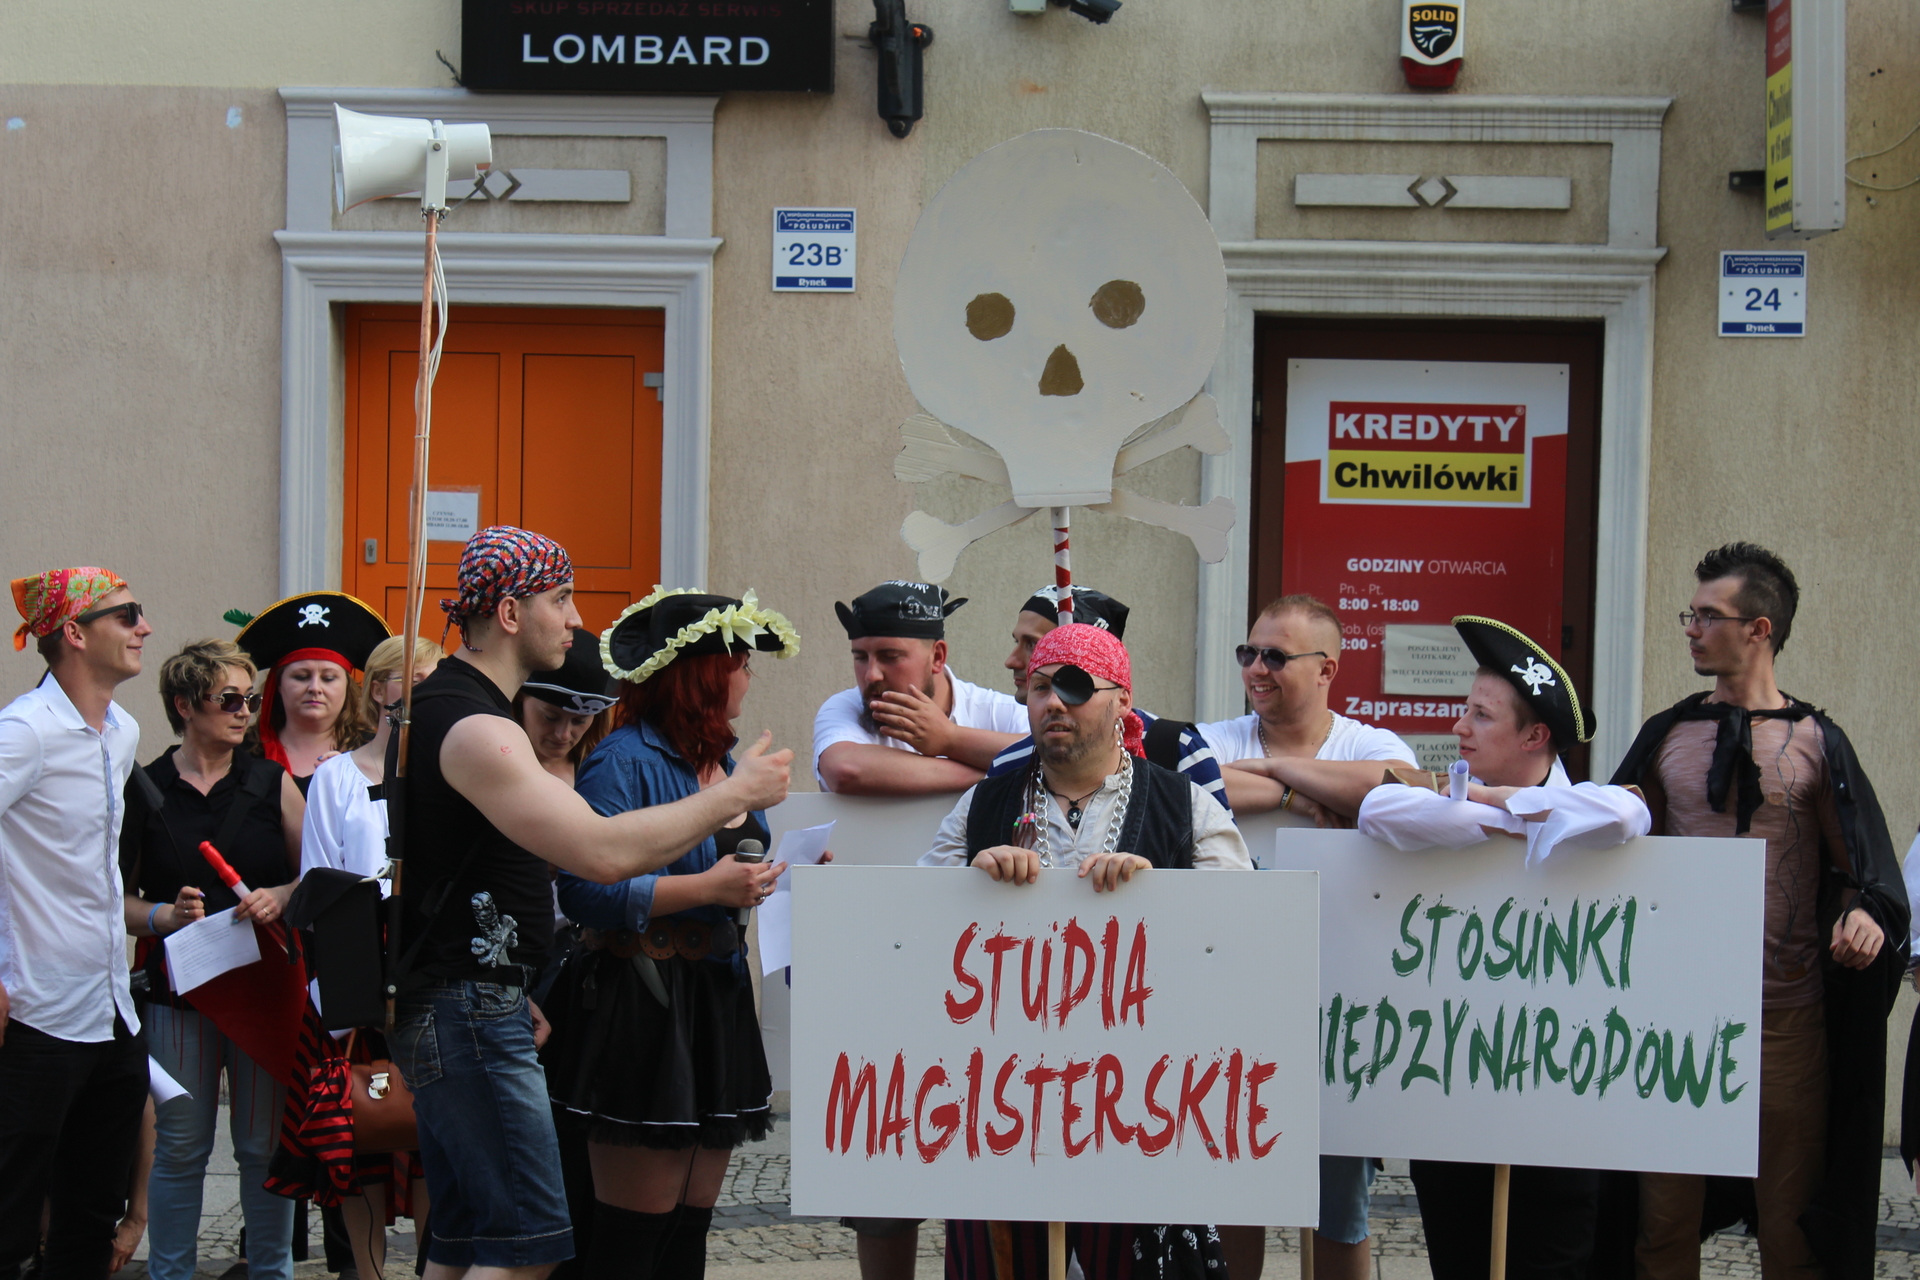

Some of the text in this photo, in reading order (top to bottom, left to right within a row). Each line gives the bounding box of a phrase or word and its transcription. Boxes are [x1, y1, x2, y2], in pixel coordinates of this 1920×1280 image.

[510, 0, 569, 15] SKUP
[698, 2, 783, 18] SERWIS
[1412, 9, 1456, 22] SOLID
[522, 33, 770, 66] LOMBARD
[789, 242, 842, 266] 23B
[798, 278, 827, 288] Rynek
[1745, 287, 1782, 311] 24
[1745, 323, 1775, 334] Rynek
[1334, 413, 1519, 442] KREDYTY
[1334, 461, 1518, 492] Chwilówki
[1346, 558, 1507, 575] GODZINY OTWARCIA
[1339, 583, 1358, 595] Pn.
[1369, 584, 1384, 596] Pt.
[1338, 598, 1369, 611] 8:00
[1381, 599, 1420, 612] 18:00
[1416, 741, 1458, 751] PLACÓW
[1391, 894, 1638, 992] STOSUNKI
[944, 915, 1153, 1035] STUDIA
[1319, 992, 1750, 1109] IĘDZYNARODOWE
[825, 1046, 1284, 1167] MAGISTERSKIE
